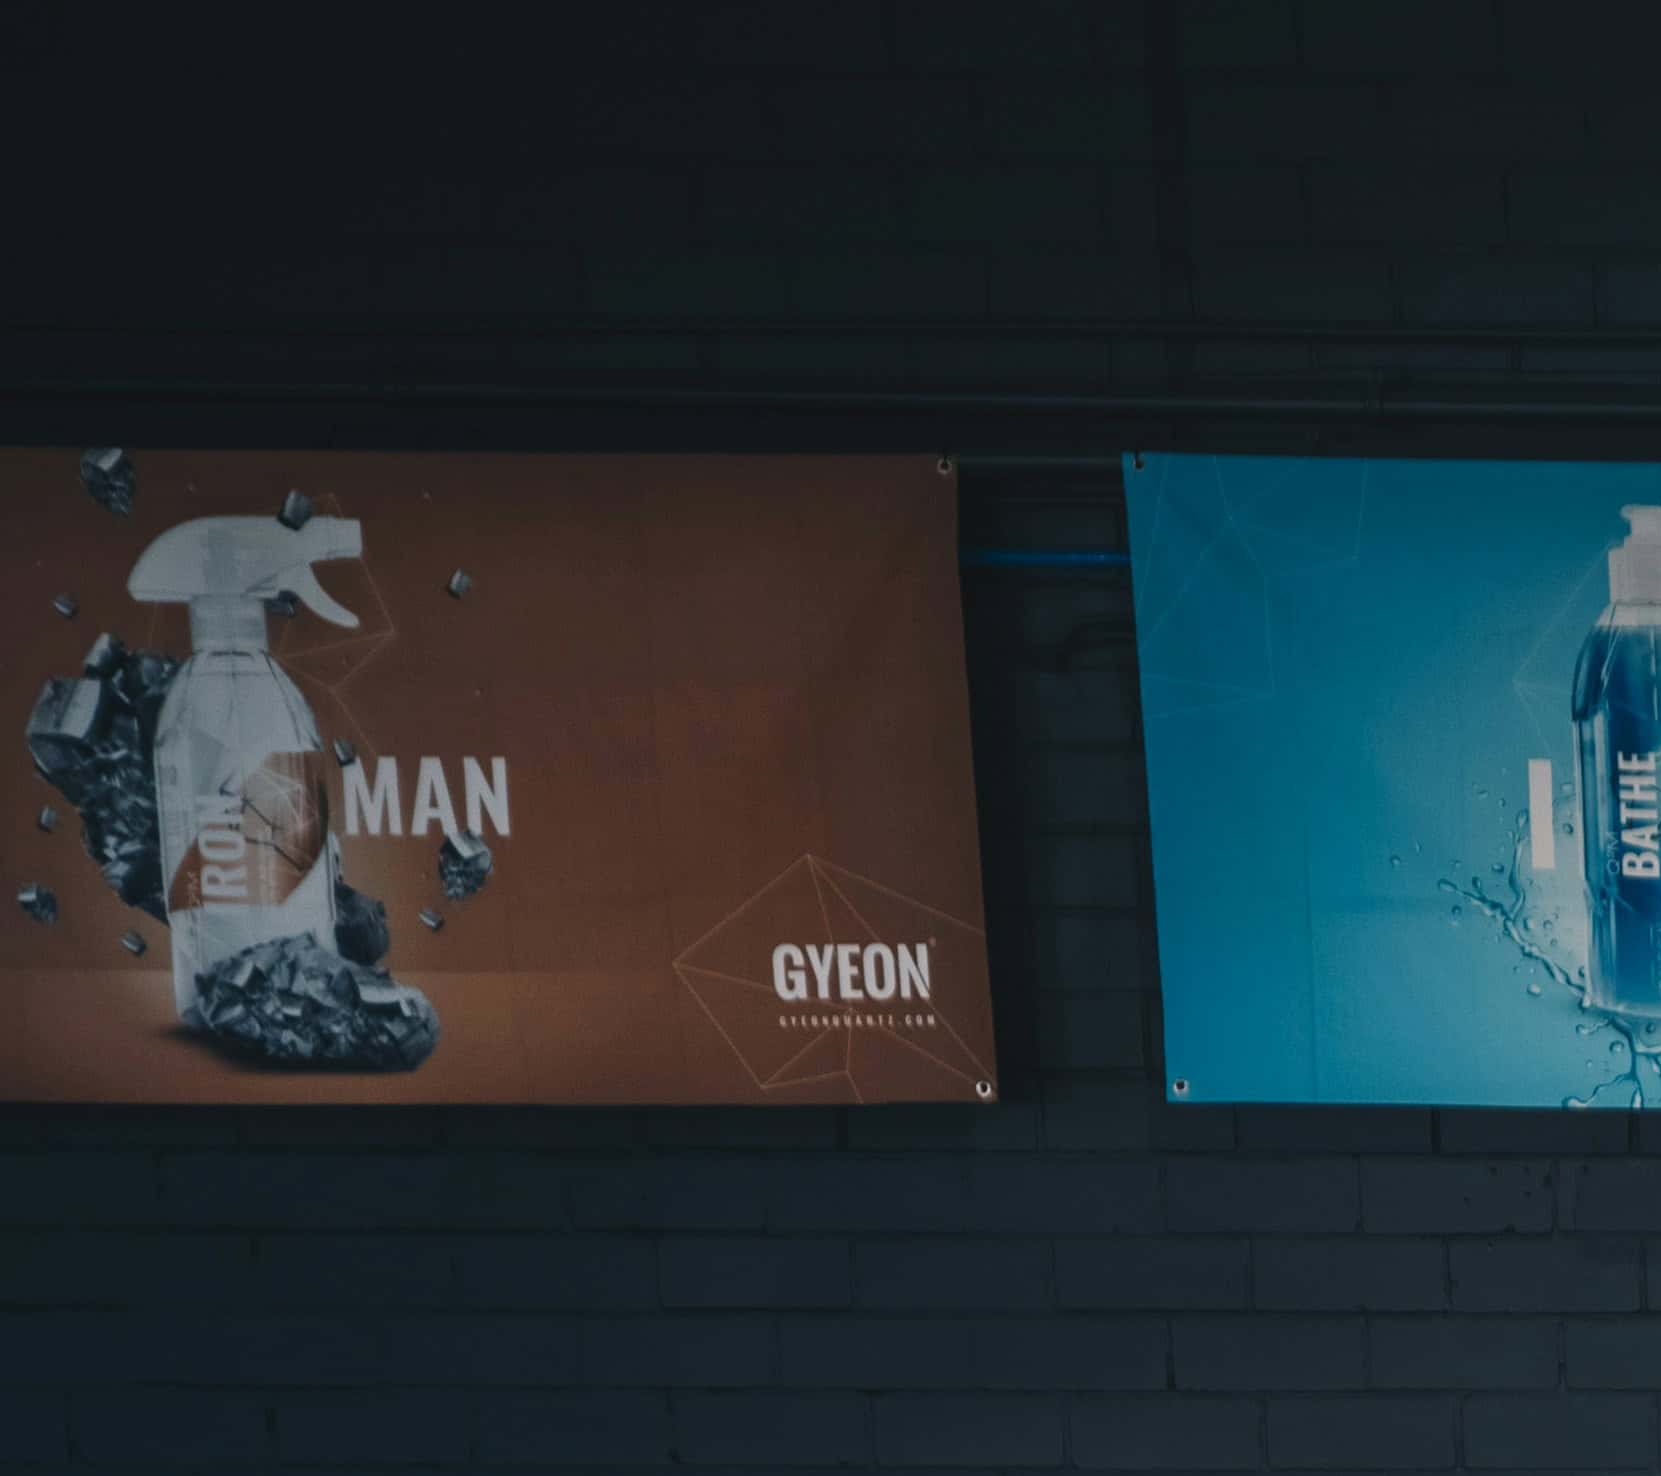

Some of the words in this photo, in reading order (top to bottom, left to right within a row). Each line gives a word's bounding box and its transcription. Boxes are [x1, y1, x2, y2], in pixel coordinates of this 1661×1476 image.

[341, 755, 511, 837] MAN
[1528, 759, 1555, 870] I
[1618, 752, 1661, 877] BATHE
[772, 943, 931, 1000] GYEON
